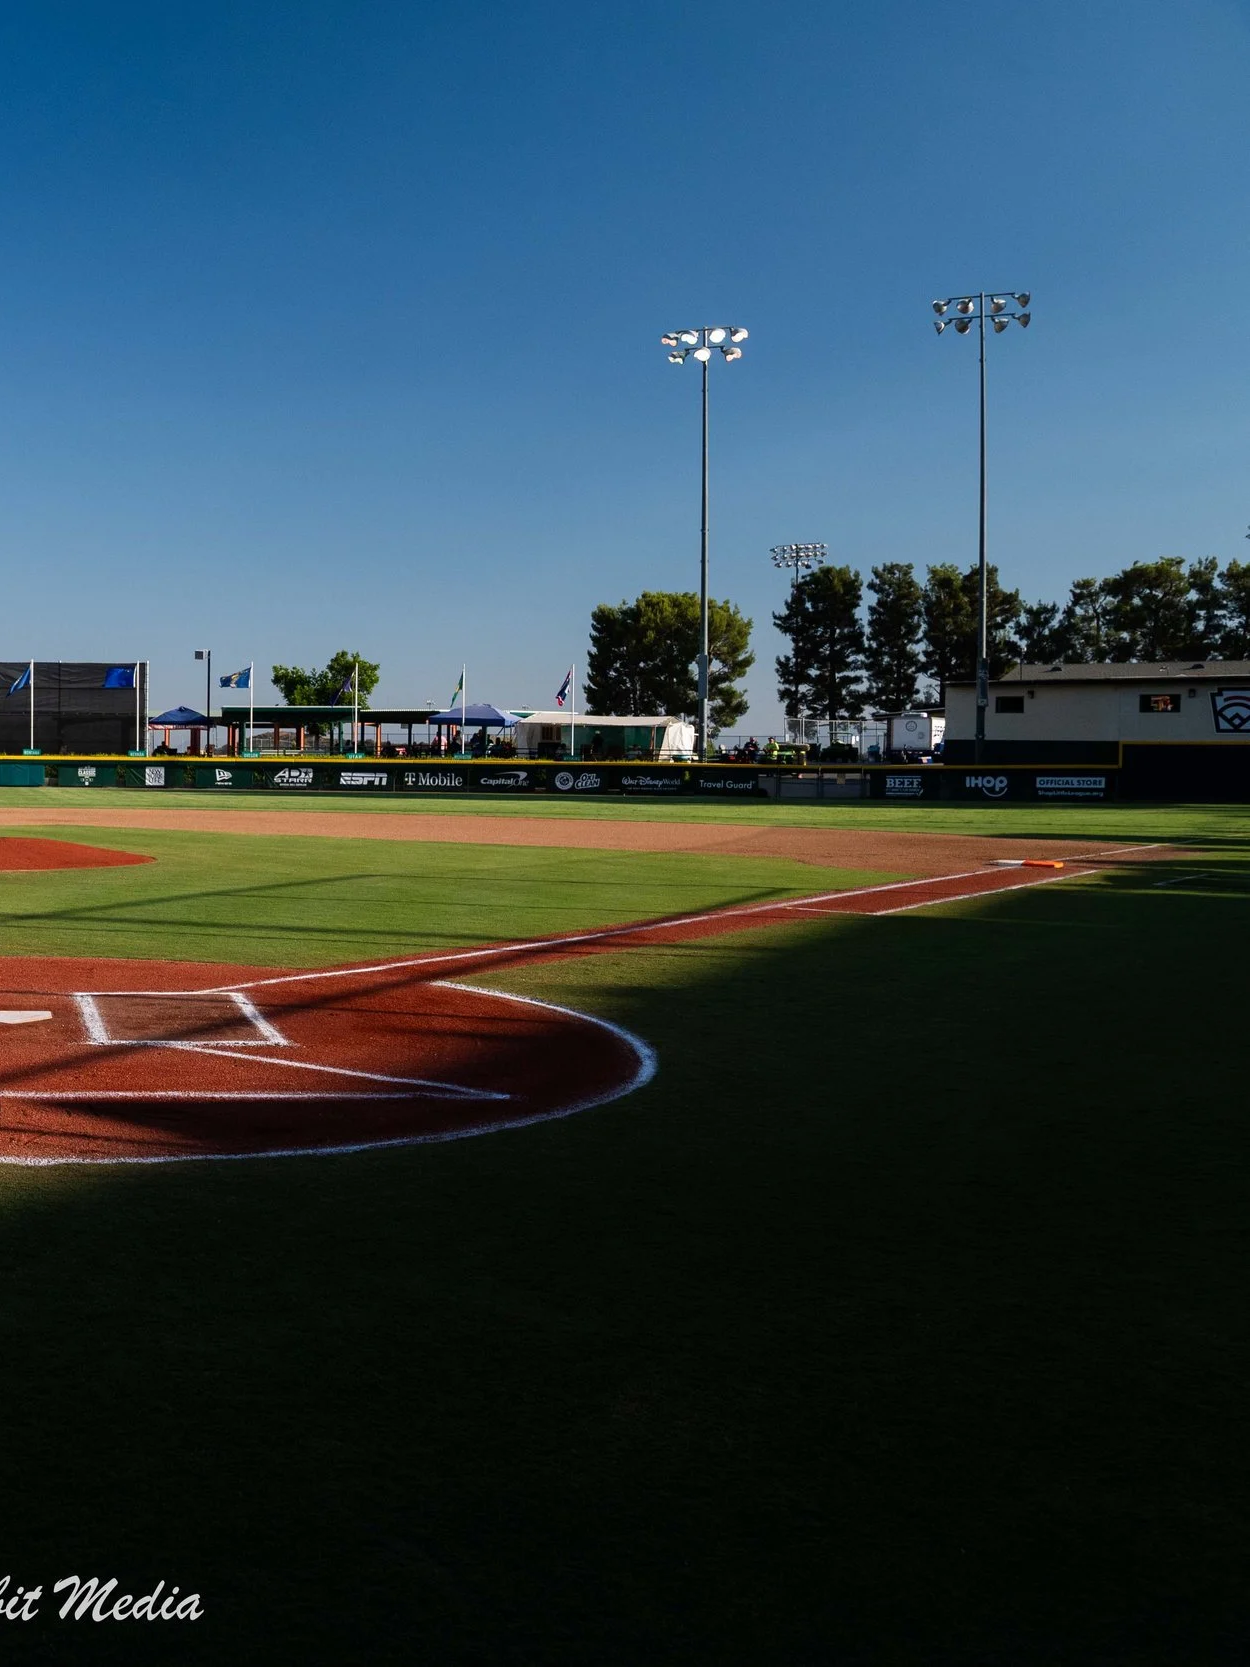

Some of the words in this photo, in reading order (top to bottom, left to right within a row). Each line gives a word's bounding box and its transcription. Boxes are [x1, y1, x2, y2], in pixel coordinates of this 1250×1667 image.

[340, 772, 387, 785] ESPN
[418, 772, 463, 786] Mobile
[700, 780, 724, 788] Travel
[575, 780, 601, 789] CLEAN
